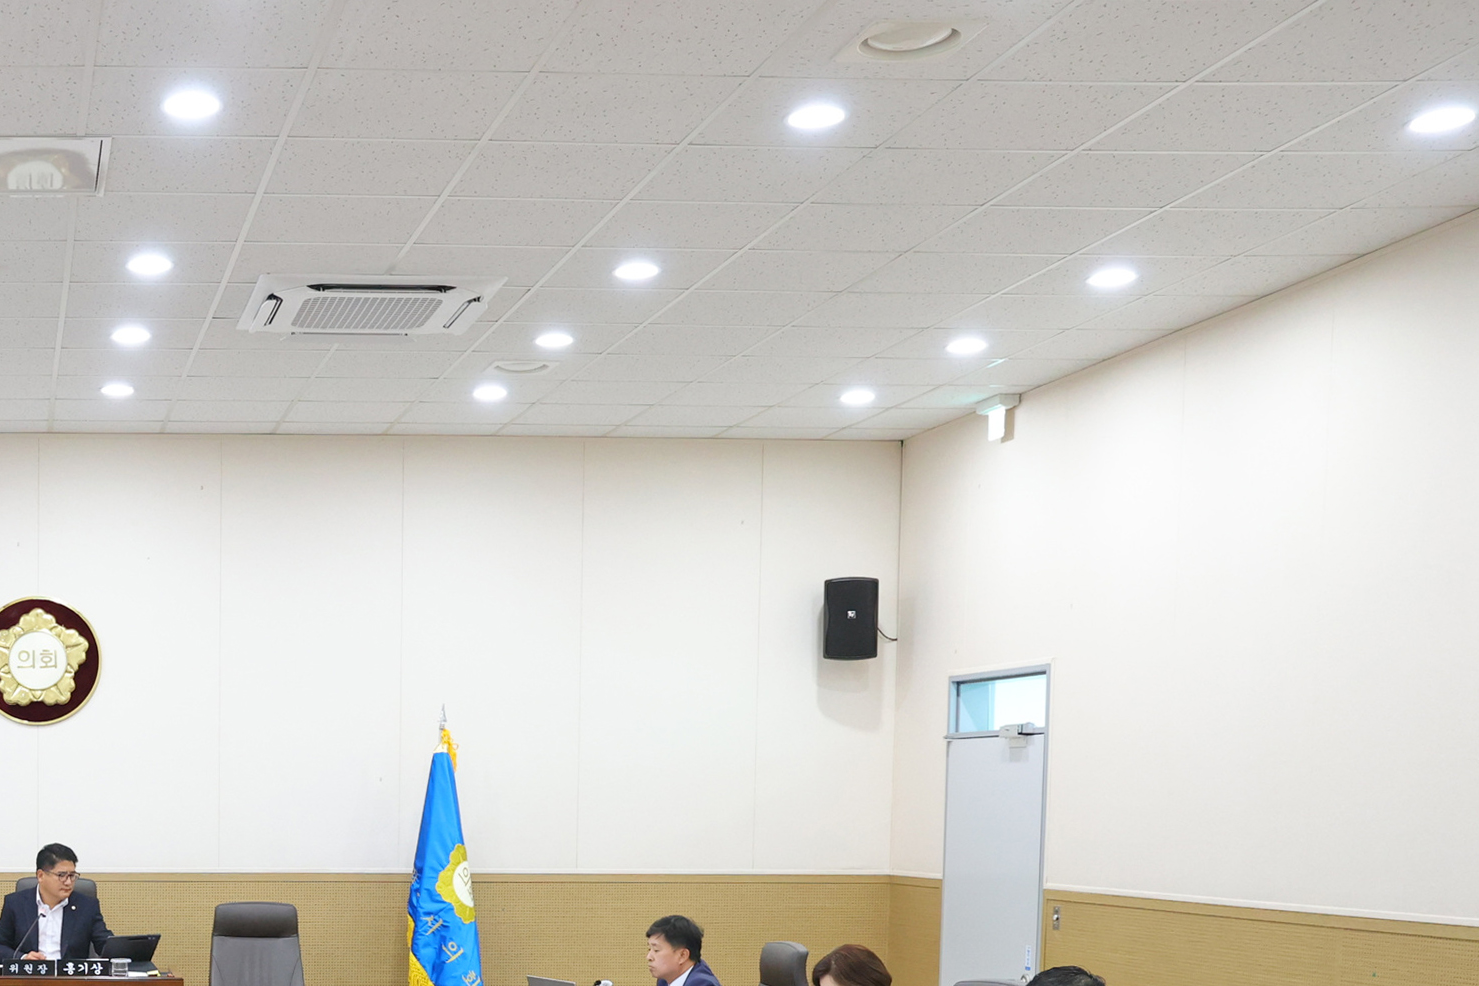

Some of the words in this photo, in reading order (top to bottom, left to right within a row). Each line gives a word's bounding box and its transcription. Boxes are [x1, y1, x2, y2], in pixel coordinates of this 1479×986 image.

[16, 649, 58, 670] 의회
[8, 963, 49, 975] 위원장
[62, 961, 104, 976] 홍기상
